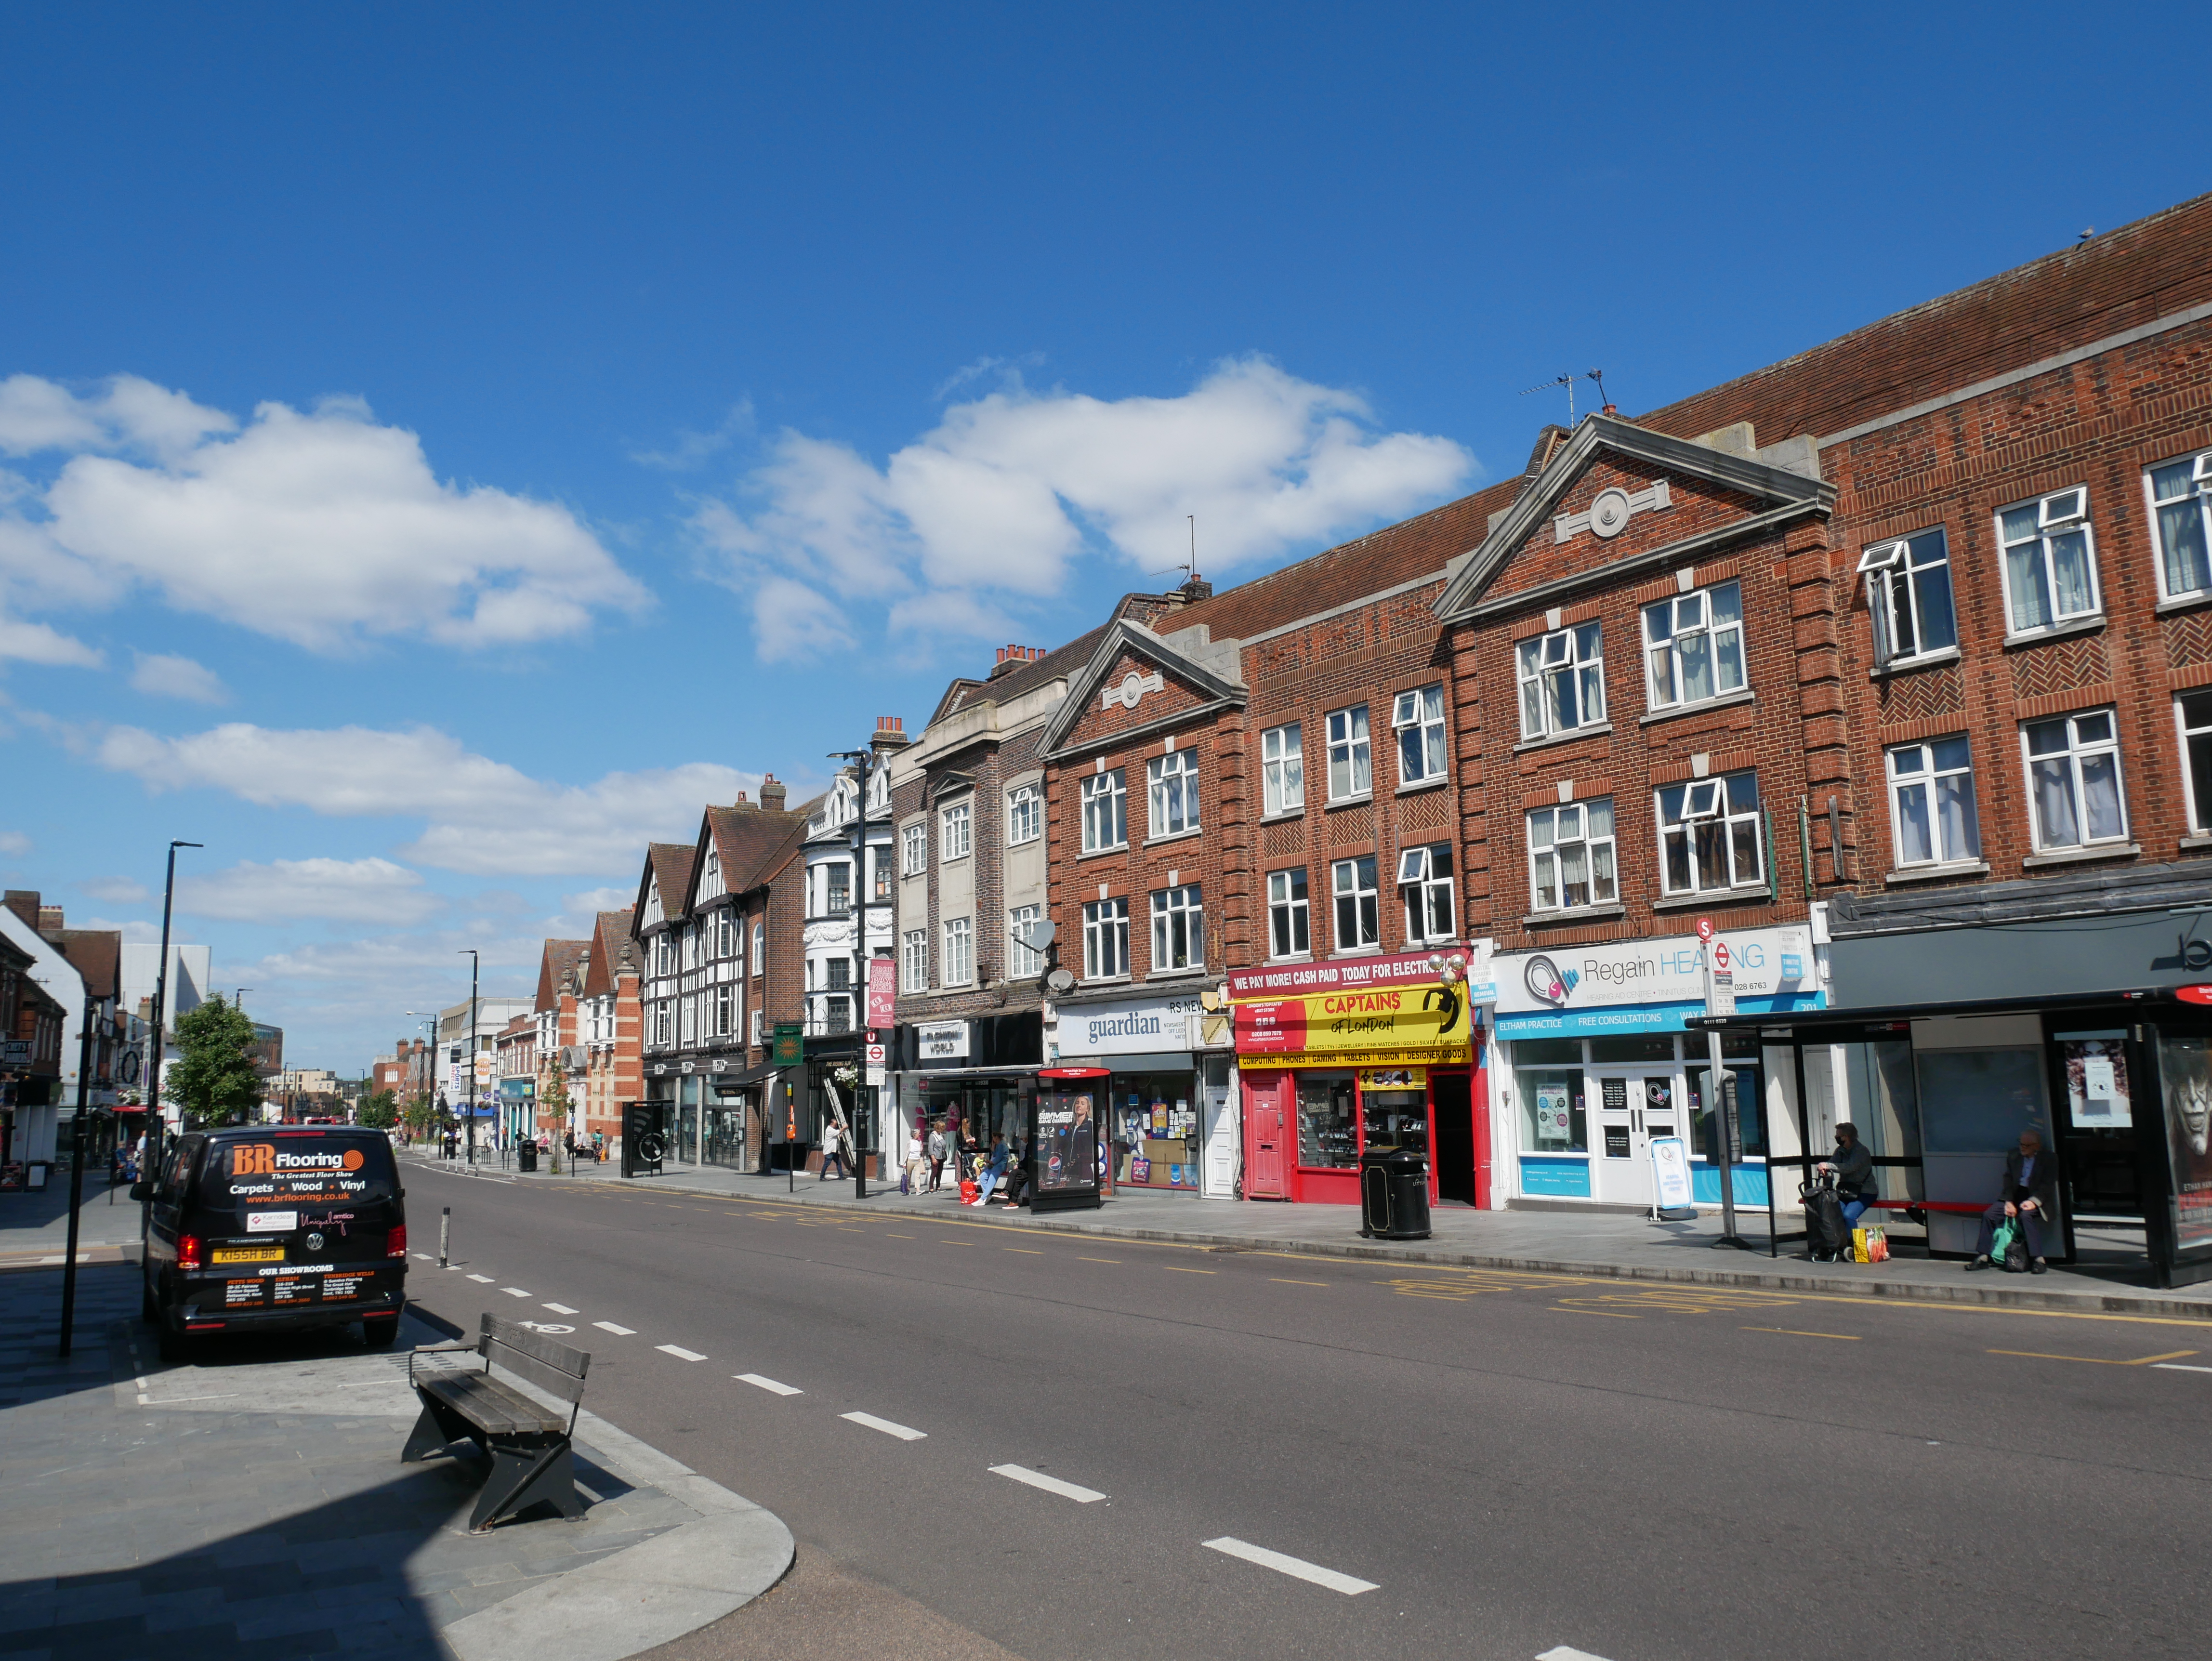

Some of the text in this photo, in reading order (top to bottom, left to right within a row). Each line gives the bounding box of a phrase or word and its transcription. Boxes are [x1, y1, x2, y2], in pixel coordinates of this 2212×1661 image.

[1701, 922, 1710, 936] S
[1584, 944, 1764, 985] Regain HEANG
[1234, 977, 1248, 989] WE
[1249, 976, 1264, 989] PAY
[1266, 973, 1291, 987] MORE!
[1293, 971, 1317, 984] CASH
[1318, 969, 1338, 982] PAID
[1342, 965, 1370, 980] TODAY
[1373, 963, 1391, 978] FOR
[1474, 989, 1495, 998] REMOVAL
[1658, 988, 1686, 996] TINNITUS
[1170, 1002, 1181, 1014] RS
[1325, 992, 1401, 1014] CAPTAINS
[1089, 1012, 1160, 1044] guardian
[1500, 1014, 1661, 1031] ELTHAM PRACTICE FREE CONSULTATIONS
[926, 1030, 958, 1041] FASHION
[1208, 1019, 1223, 1042] photocopies
[868, 1033, 875, 1042] U
[930, 1042, 954, 1052] WORLD
[1243, 1049, 1466, 1065] COMPUTING PHONES GAMING TABLETS VISION DESIGNER GOODS
[233, 1144, 342, 1175] BR Flooring
[230, 1181, 365, 1195] Carpets Wood Vinyl
[2184, 1182, 2201, 1191] ETHAN
[246, 1192, 350, 1203] www.brflooring.co.uk
[261, 1249, 276, 1259] BR
[279, 1265, 334, 1275] SHOWROOMS
